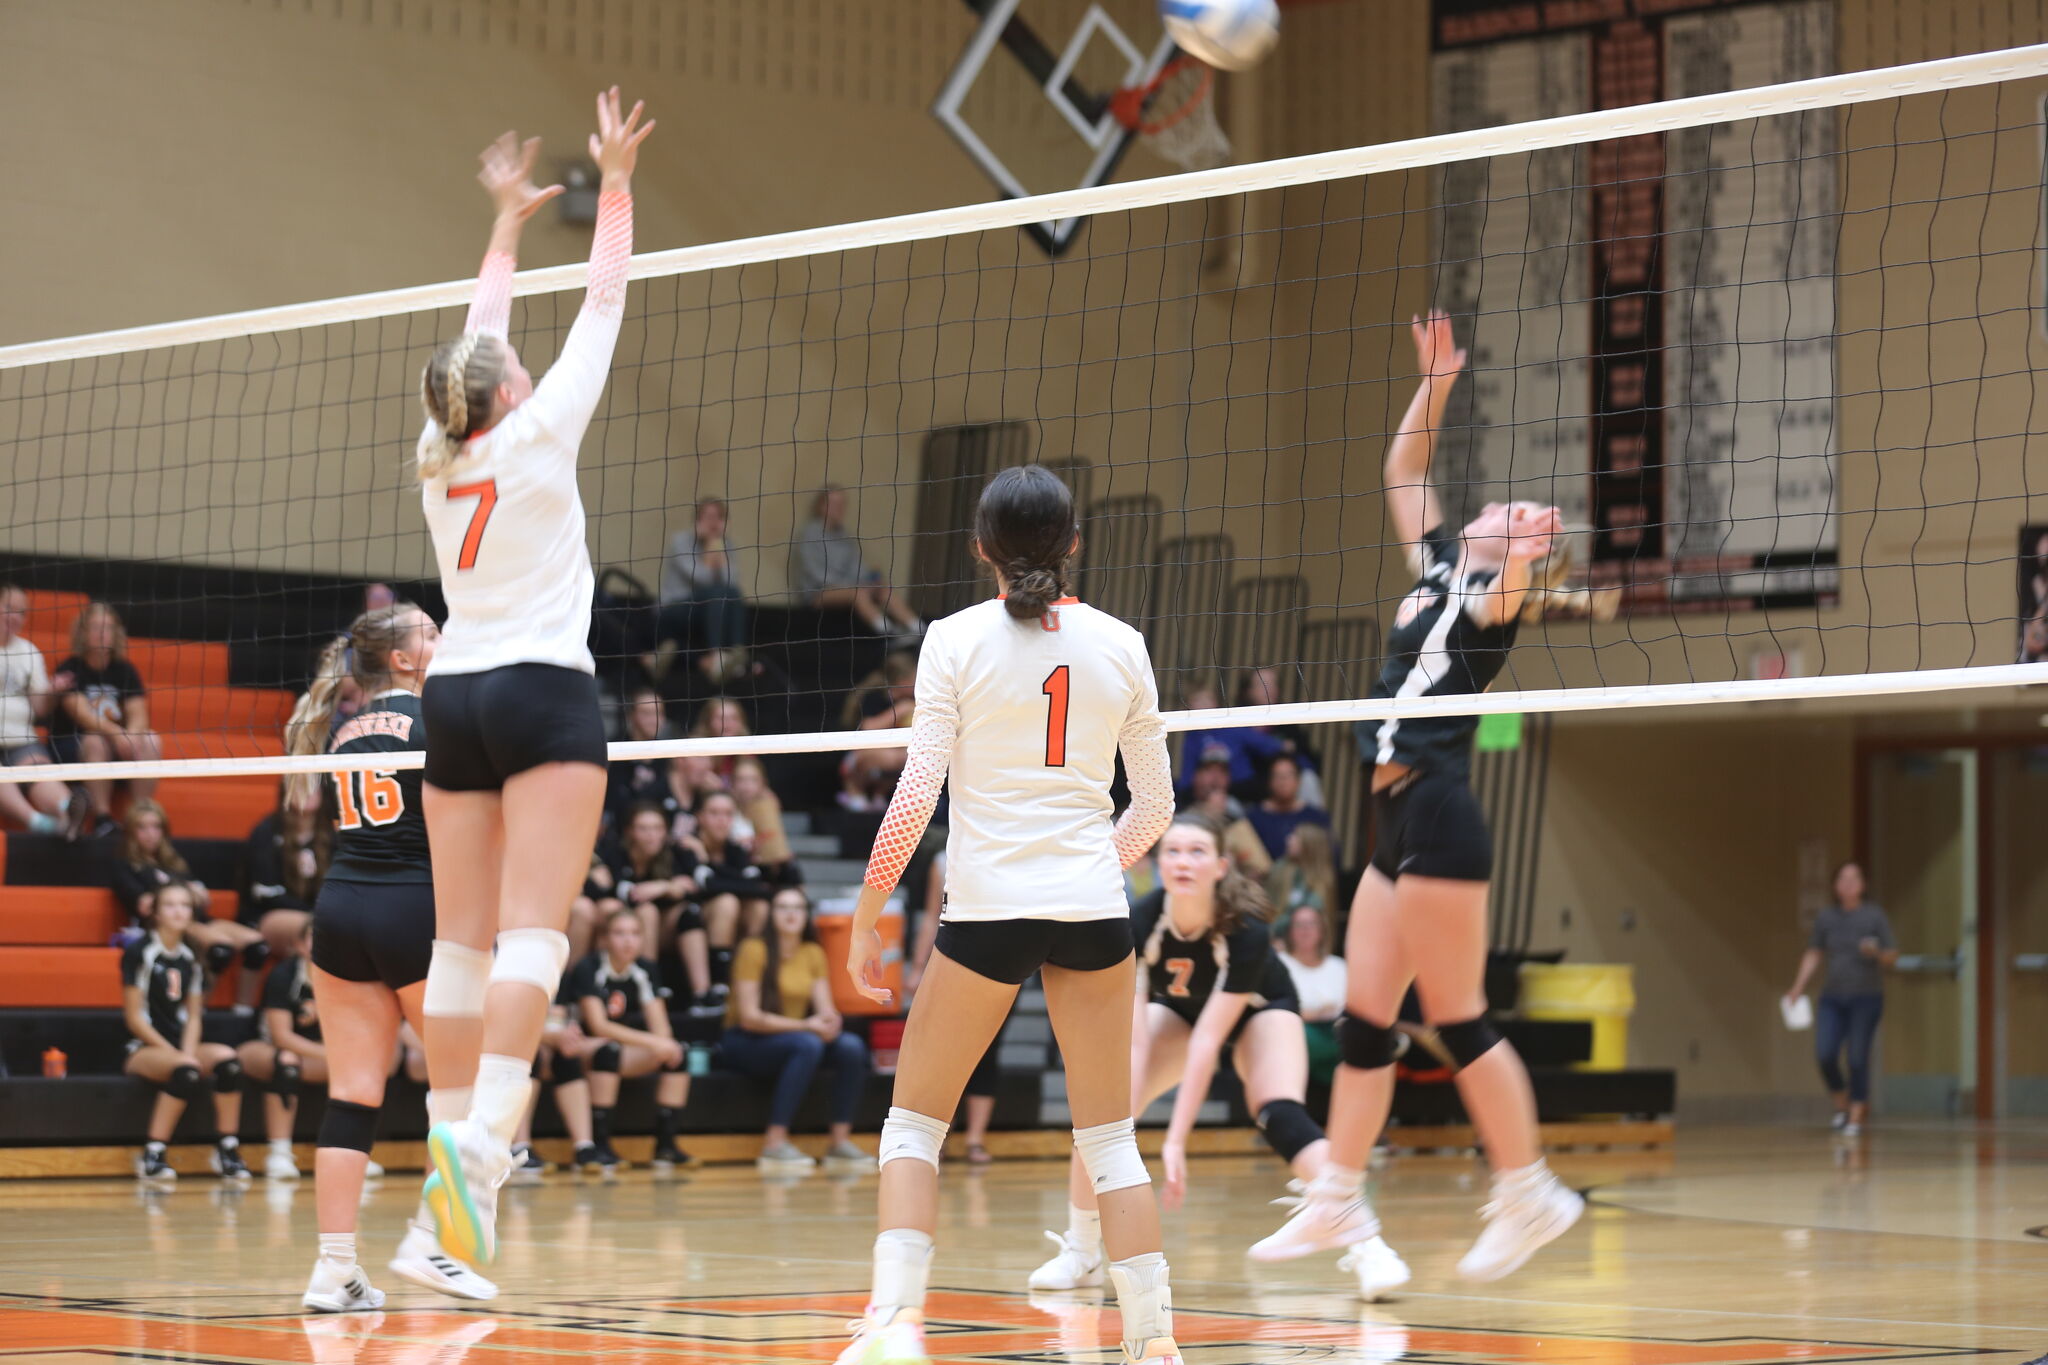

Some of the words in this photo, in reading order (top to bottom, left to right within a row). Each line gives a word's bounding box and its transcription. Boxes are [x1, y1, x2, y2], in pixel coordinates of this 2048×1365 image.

[446, 477, 498, 571] 7
[1042, 664, 1070, 767] 1
[332, 769, 405, 830] 16
[1165, 957, 1195, 997] 7
